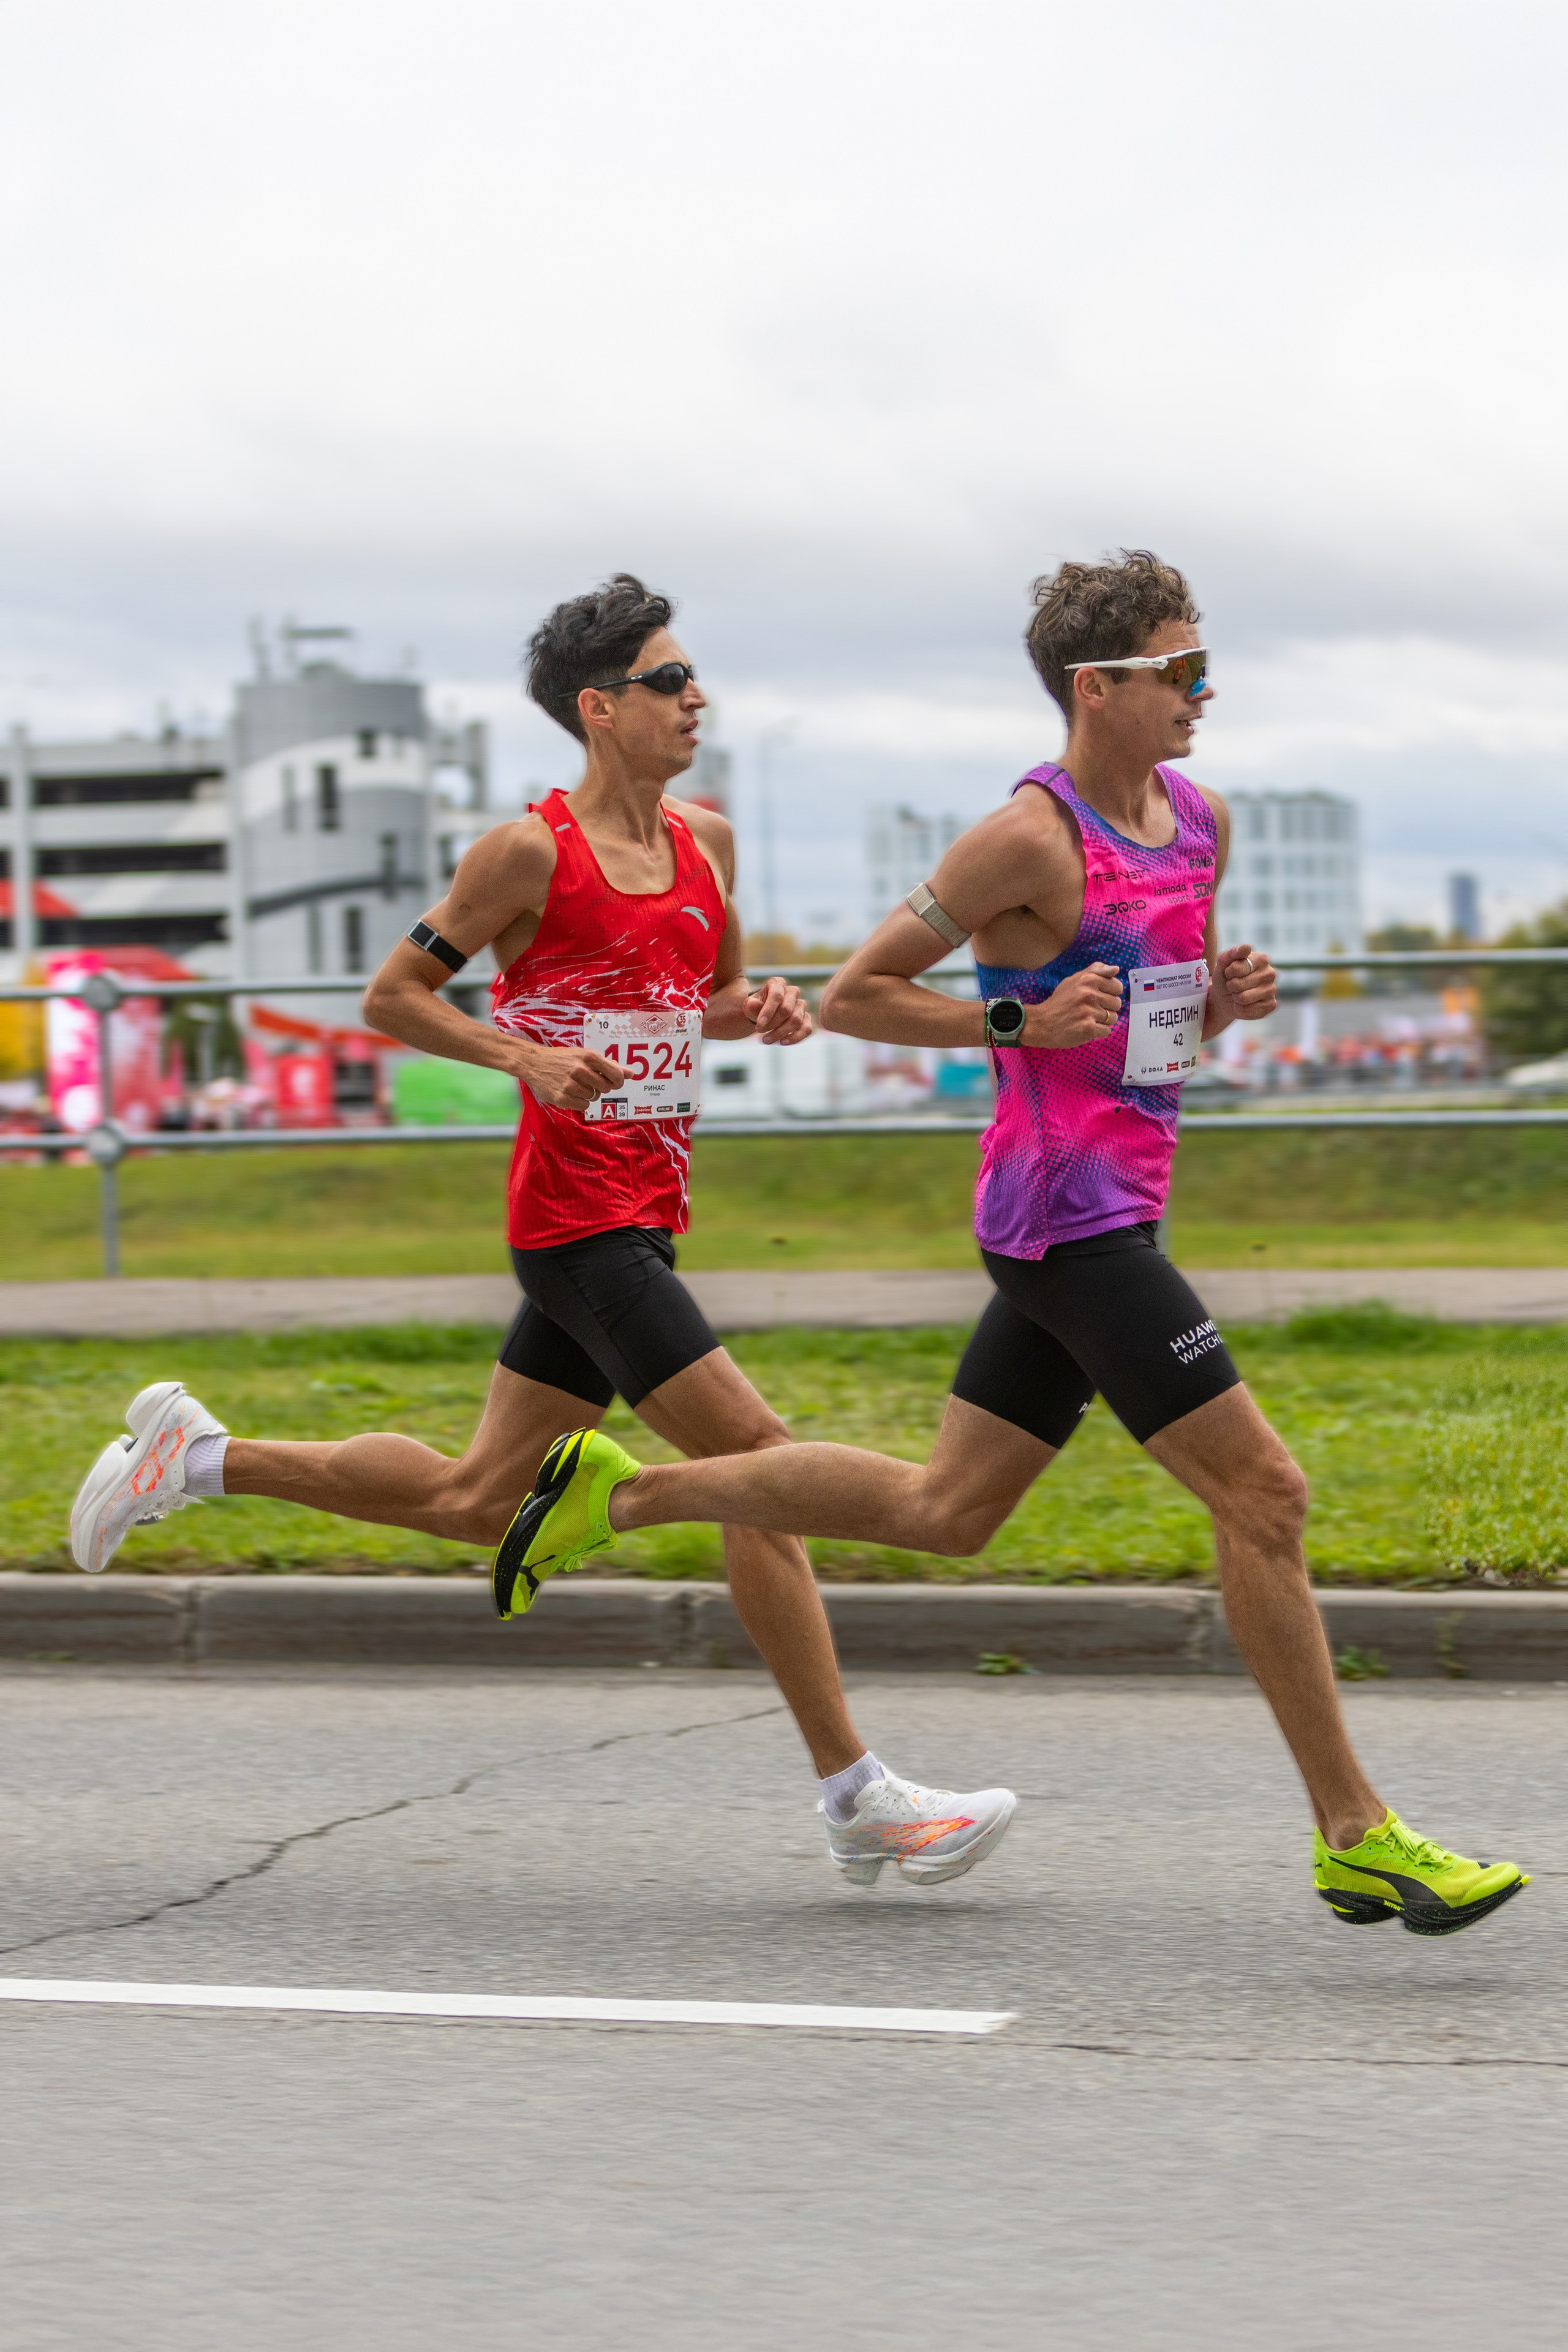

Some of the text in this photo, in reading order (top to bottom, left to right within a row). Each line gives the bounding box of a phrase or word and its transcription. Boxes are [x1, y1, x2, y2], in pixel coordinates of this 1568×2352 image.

[1093, 870, 1145, 883] TENET
[1154, 883, 1186, 896] lamoda
[1167, 893, 1190, 905] sport
[1149, 1005, 1199, 1029] НЕДЕЛИН
[1173, 1033, 1183, 1046] 42
[1383, 1899, 1401, 1912] NITRO
